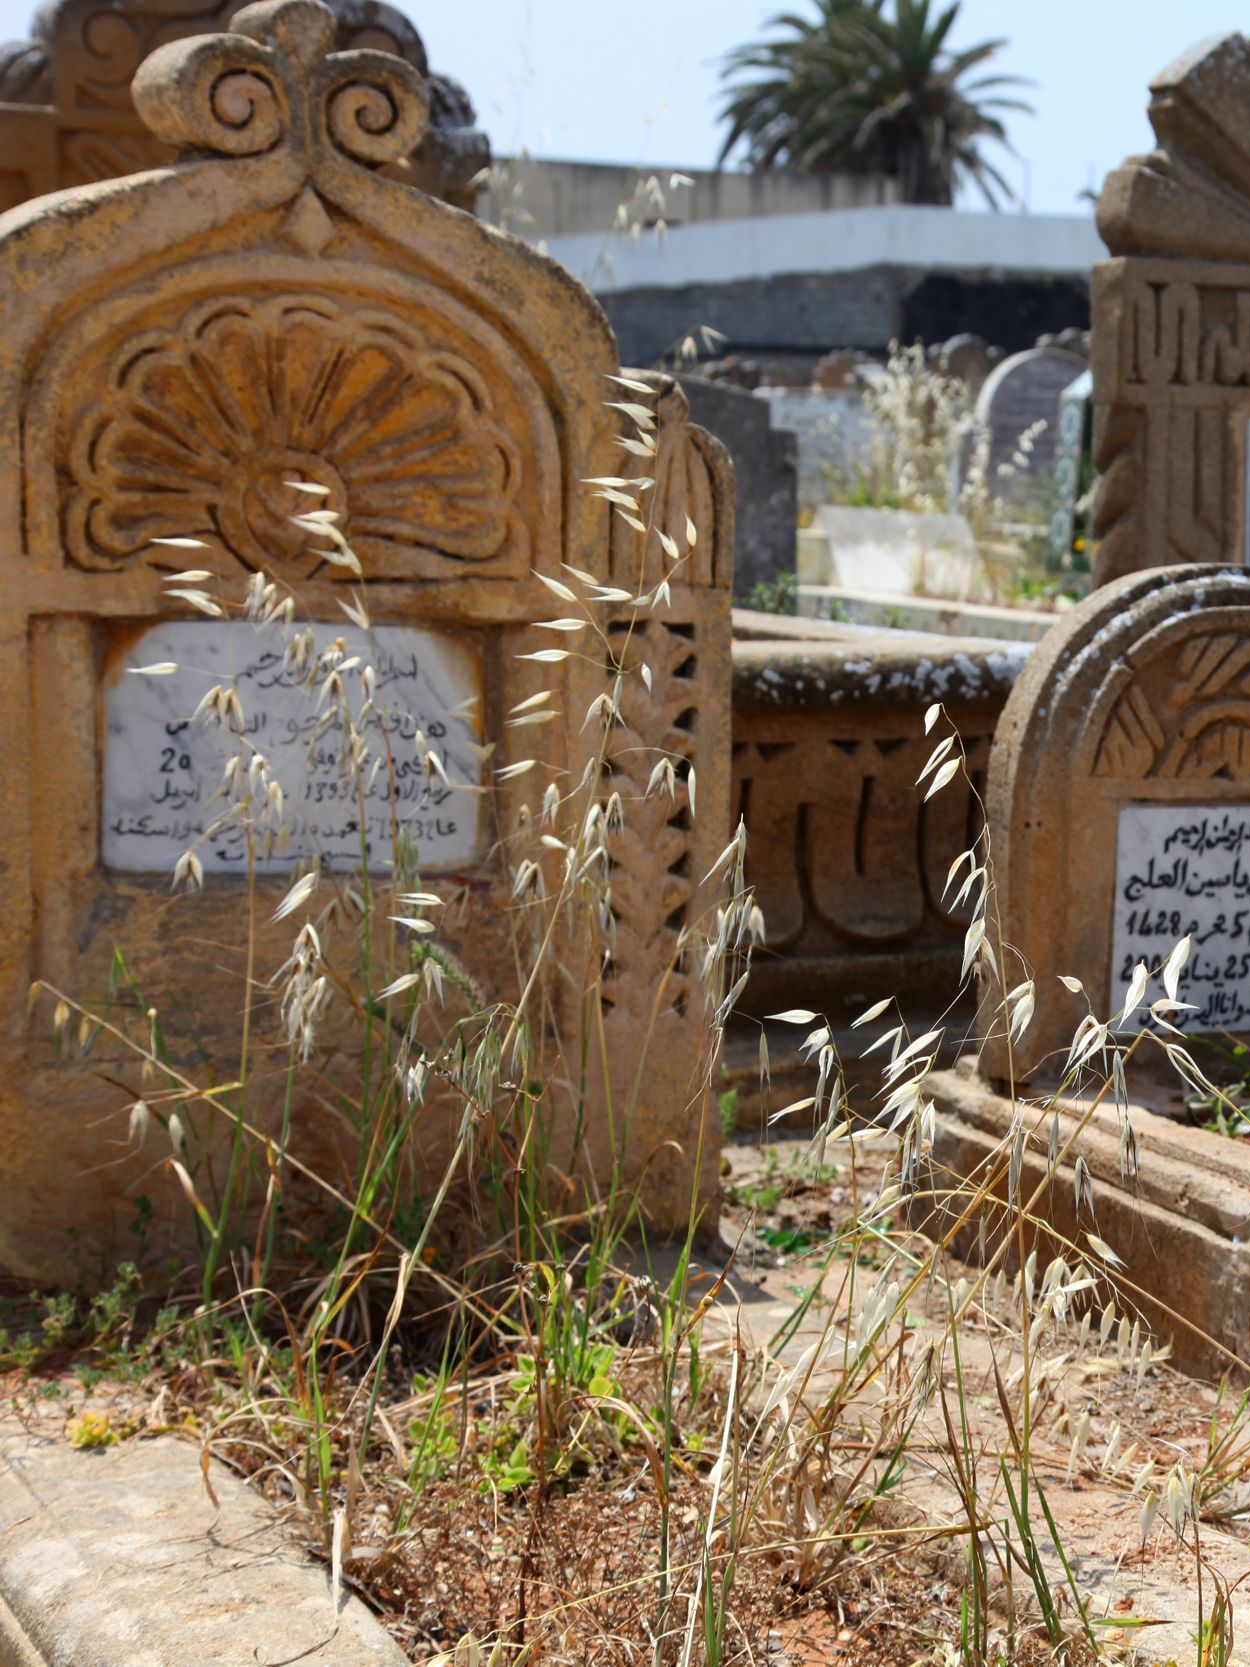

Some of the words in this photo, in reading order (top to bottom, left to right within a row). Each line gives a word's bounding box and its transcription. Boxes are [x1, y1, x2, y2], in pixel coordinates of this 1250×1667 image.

[160, 747, 191, 774] 20
[1184, 857, 1249, 899] ياسين
[1125, 906, 1181, 938] 1428
[1229, 909, 1250, 940] 5
[1158, 952, 1224, 991] يناي
